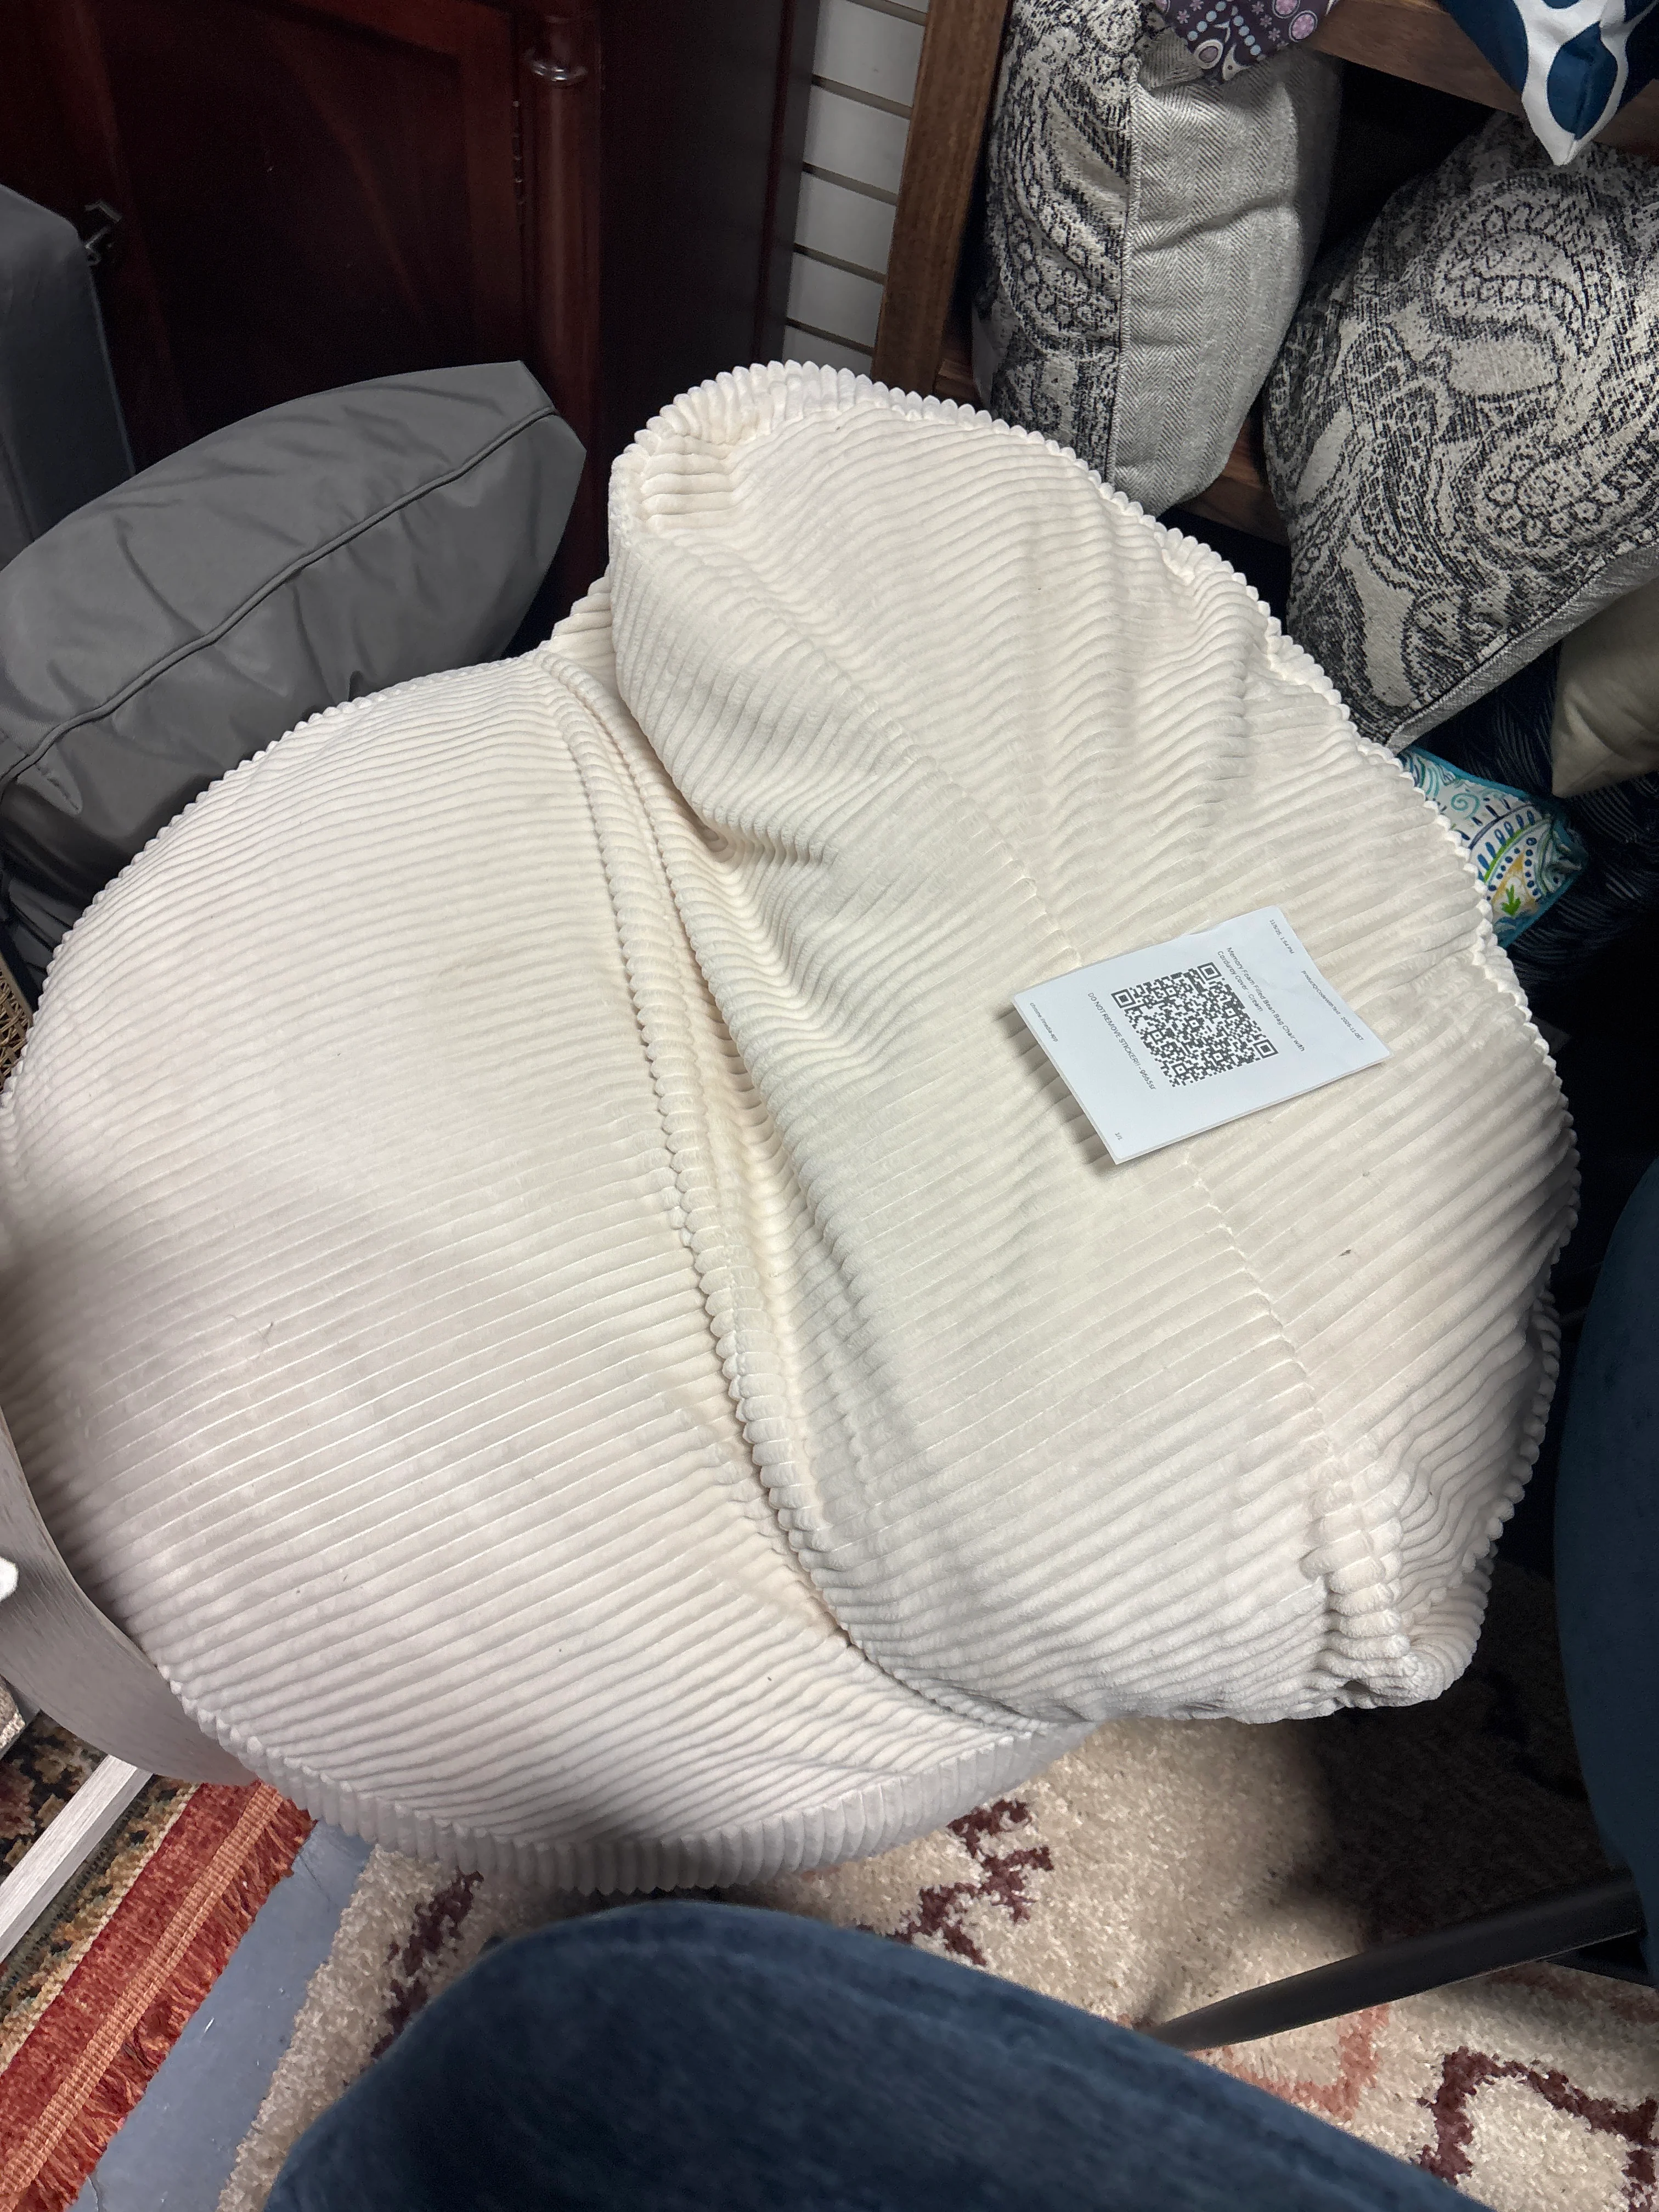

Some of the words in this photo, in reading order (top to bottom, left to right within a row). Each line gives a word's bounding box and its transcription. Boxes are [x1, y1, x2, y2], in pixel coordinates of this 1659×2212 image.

[1217, 951, 1238, 974] Corduroy
[1234, 976, 1249, 990] Cover
[1249, 994, 1263, 1013] Cream
[1227, 947, 1244, 970] Memory
[1243, 970, 1255, 985] Foam
[1253, 985, 1266, 999] Filled
[1263, 1000, 1276, 1014] Bean
[1273, 1014, 1284, 1026] Bag
[1283, 1025, 1295, 1039] Chair
[1293, 1039, 1305, 1053] with
[1088, 992, 1097, 1002] DO
[1094, 1002, 1106, 1013] NOT
[1102, 1013, 1122, 1039] REMOVE
[1119, 1039, 1141, 1066] STICKER!!
